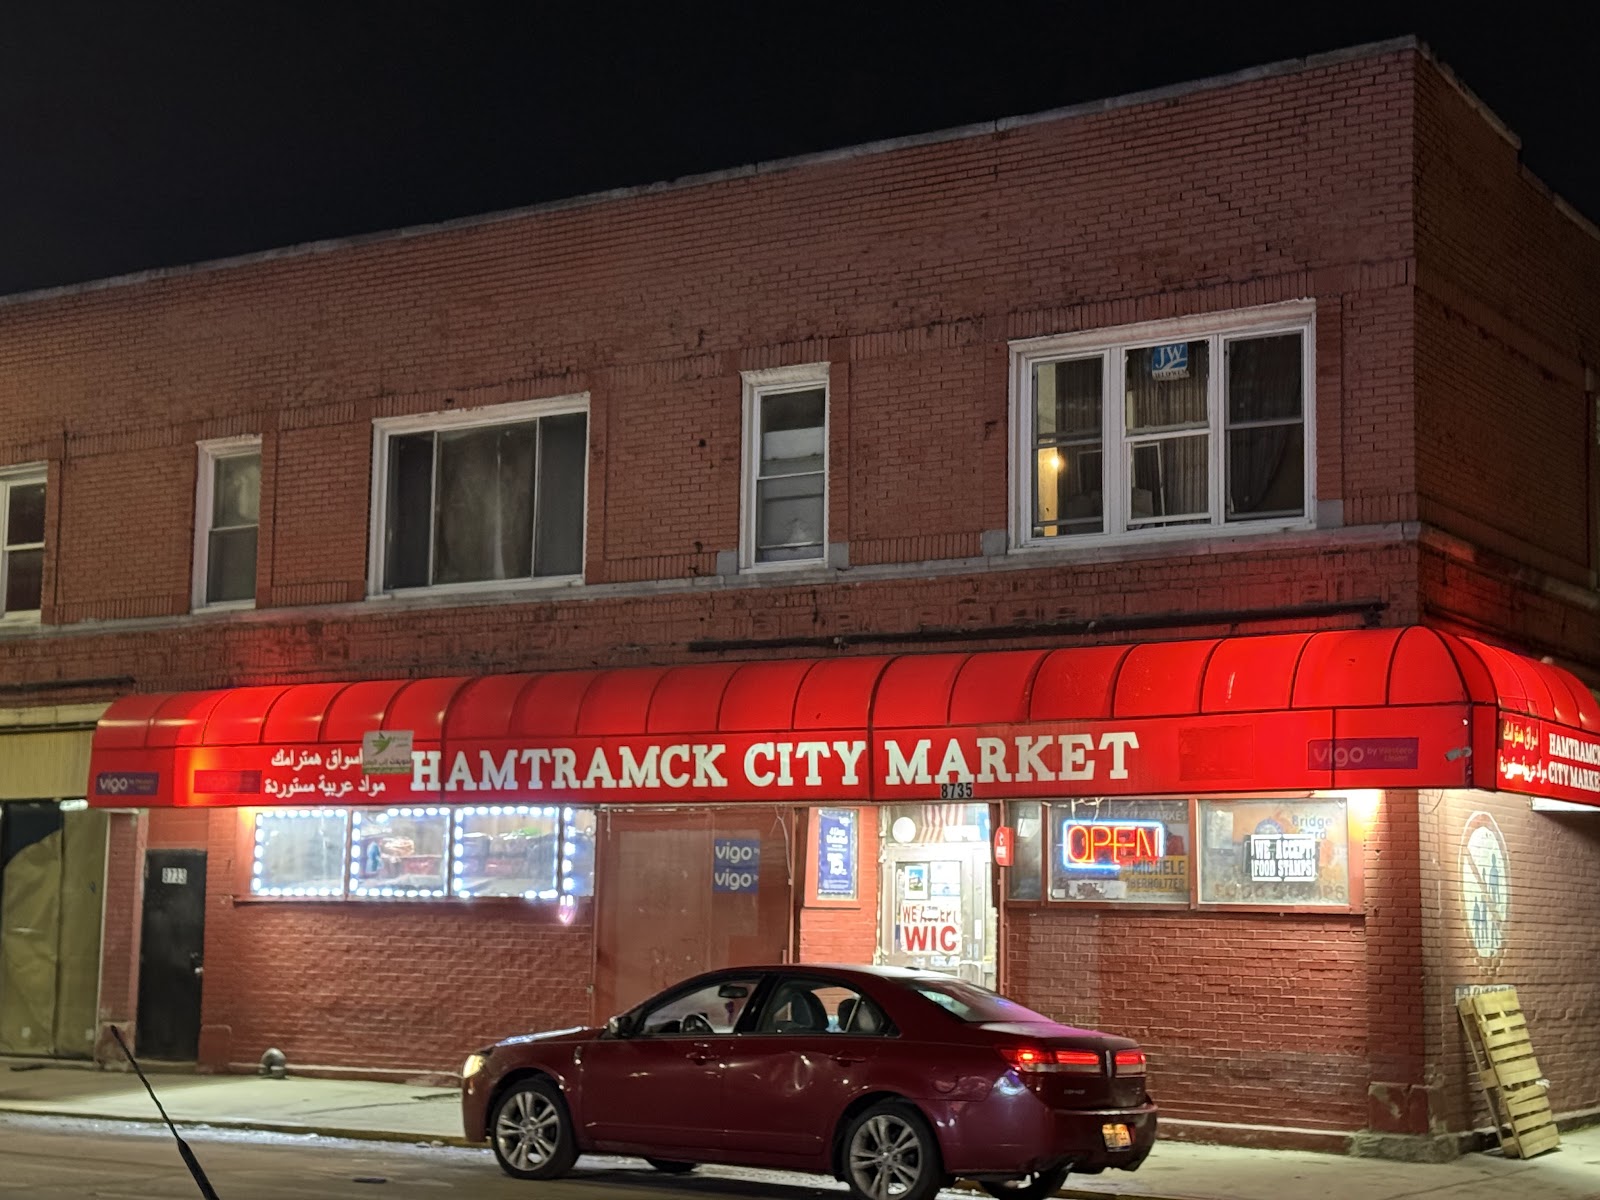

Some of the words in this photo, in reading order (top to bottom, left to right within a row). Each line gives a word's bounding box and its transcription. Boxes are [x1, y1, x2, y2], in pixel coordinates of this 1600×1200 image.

[1155, 344, 1184, 368] JW
[410, 743, 728, 792] HAMTRAMCK
[743, 740, 867, 787] CITY
[884, 731, 1140, 786] MARKET
[1313, 740, 1364, 768] vigo
[99, 773, 128, 793] vigo
[1548, 760, 1570, 786] CITY
[264, 777, 316, 798] مستوردة
[318, 775, 354, 798] عربية
[358, 775, 386, 797] مواد
[941, 783, 974, 799] 8735
[1292, 814, 1333, 830] Bridge
[714, 841, 752, 864] vigo
[1067, 825, 1162, 863] OPEN
[1255, 840, 1272, 860] WE
[1275, 840, 1314, 860] ACCEPT
[1131, 859, 1185, 876] MICHELE
[1254, 860, 1276, 877] FOOD
[1278, 860, 1313, 877] STAMPS
[714, 868, 752, 891] vigo
[902, 905, 917, 923] WE
[904, 925, 957, 952] WIC
